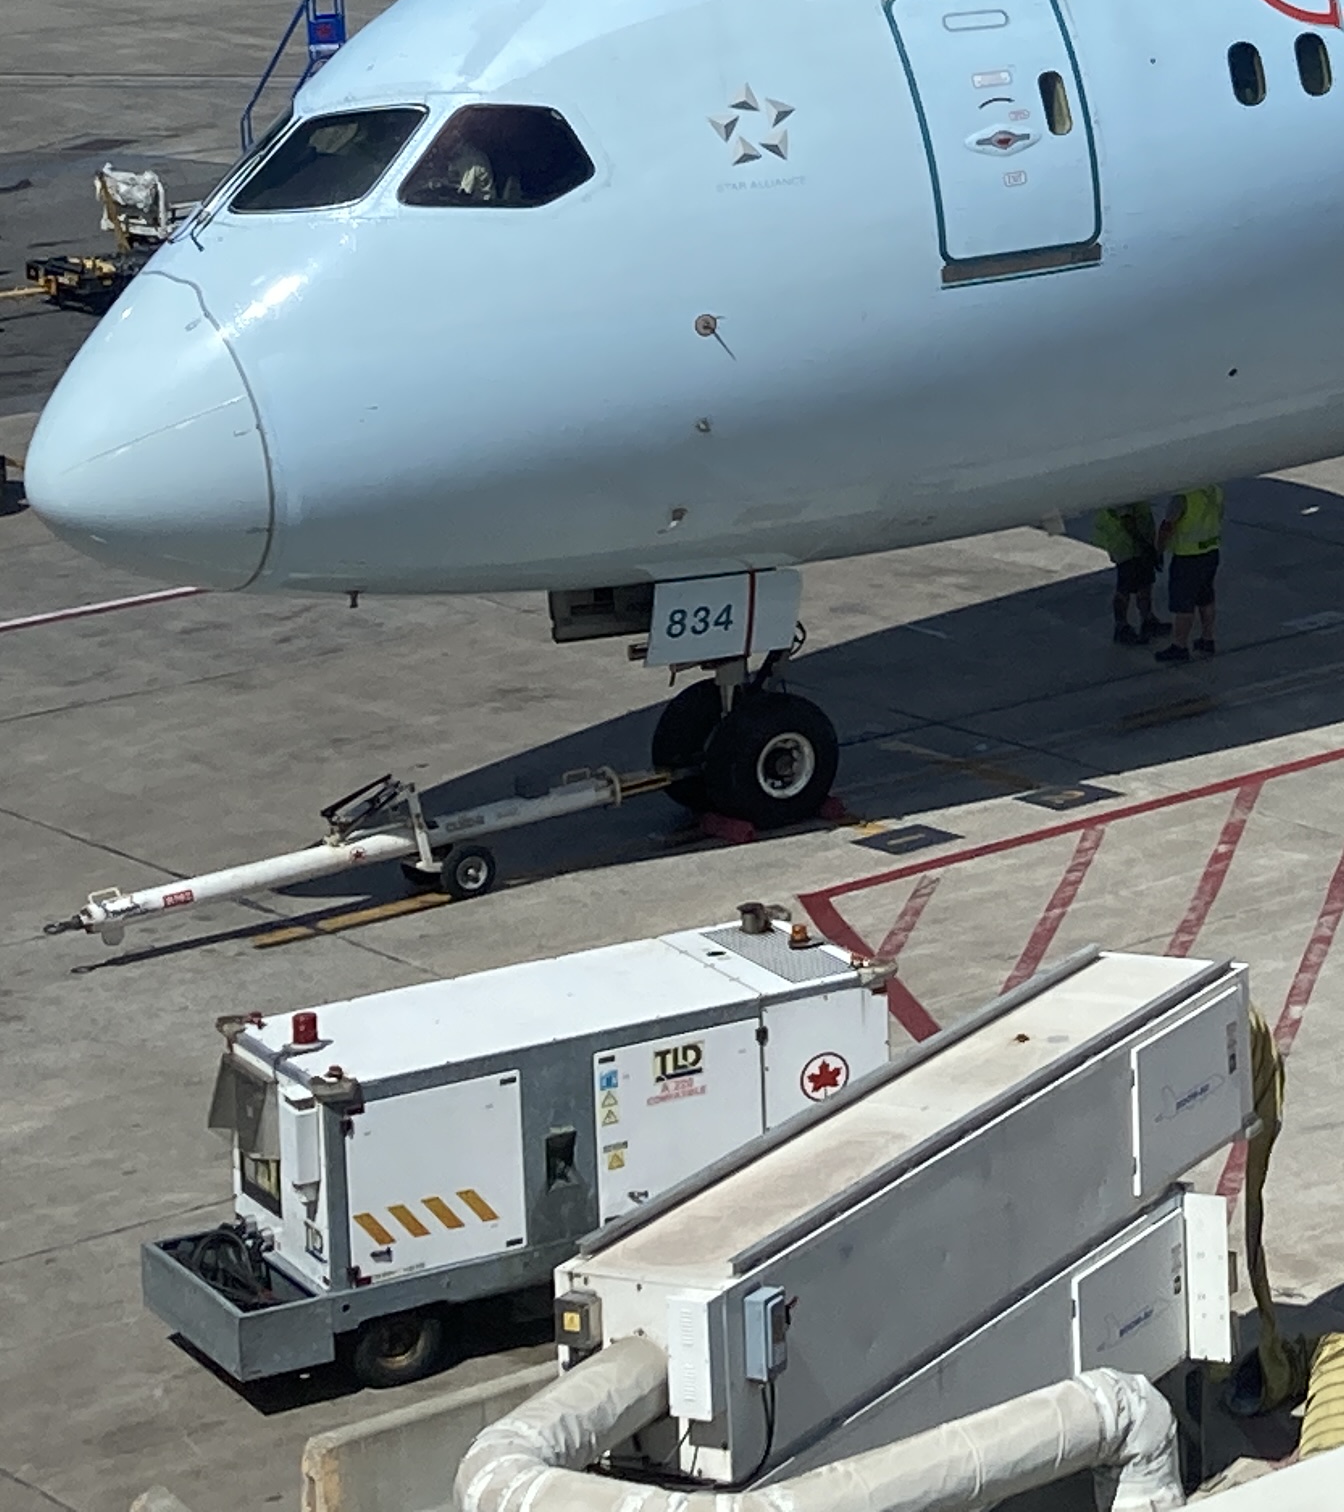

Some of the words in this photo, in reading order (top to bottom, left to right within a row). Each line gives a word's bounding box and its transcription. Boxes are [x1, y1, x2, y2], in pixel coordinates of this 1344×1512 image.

[714, 180, 747, 194] STAR
[749, 175, 807, 191] ALLIANCE
[665, 603, 734, 639] 834
[653, 1043, 703, 1076] TLD
